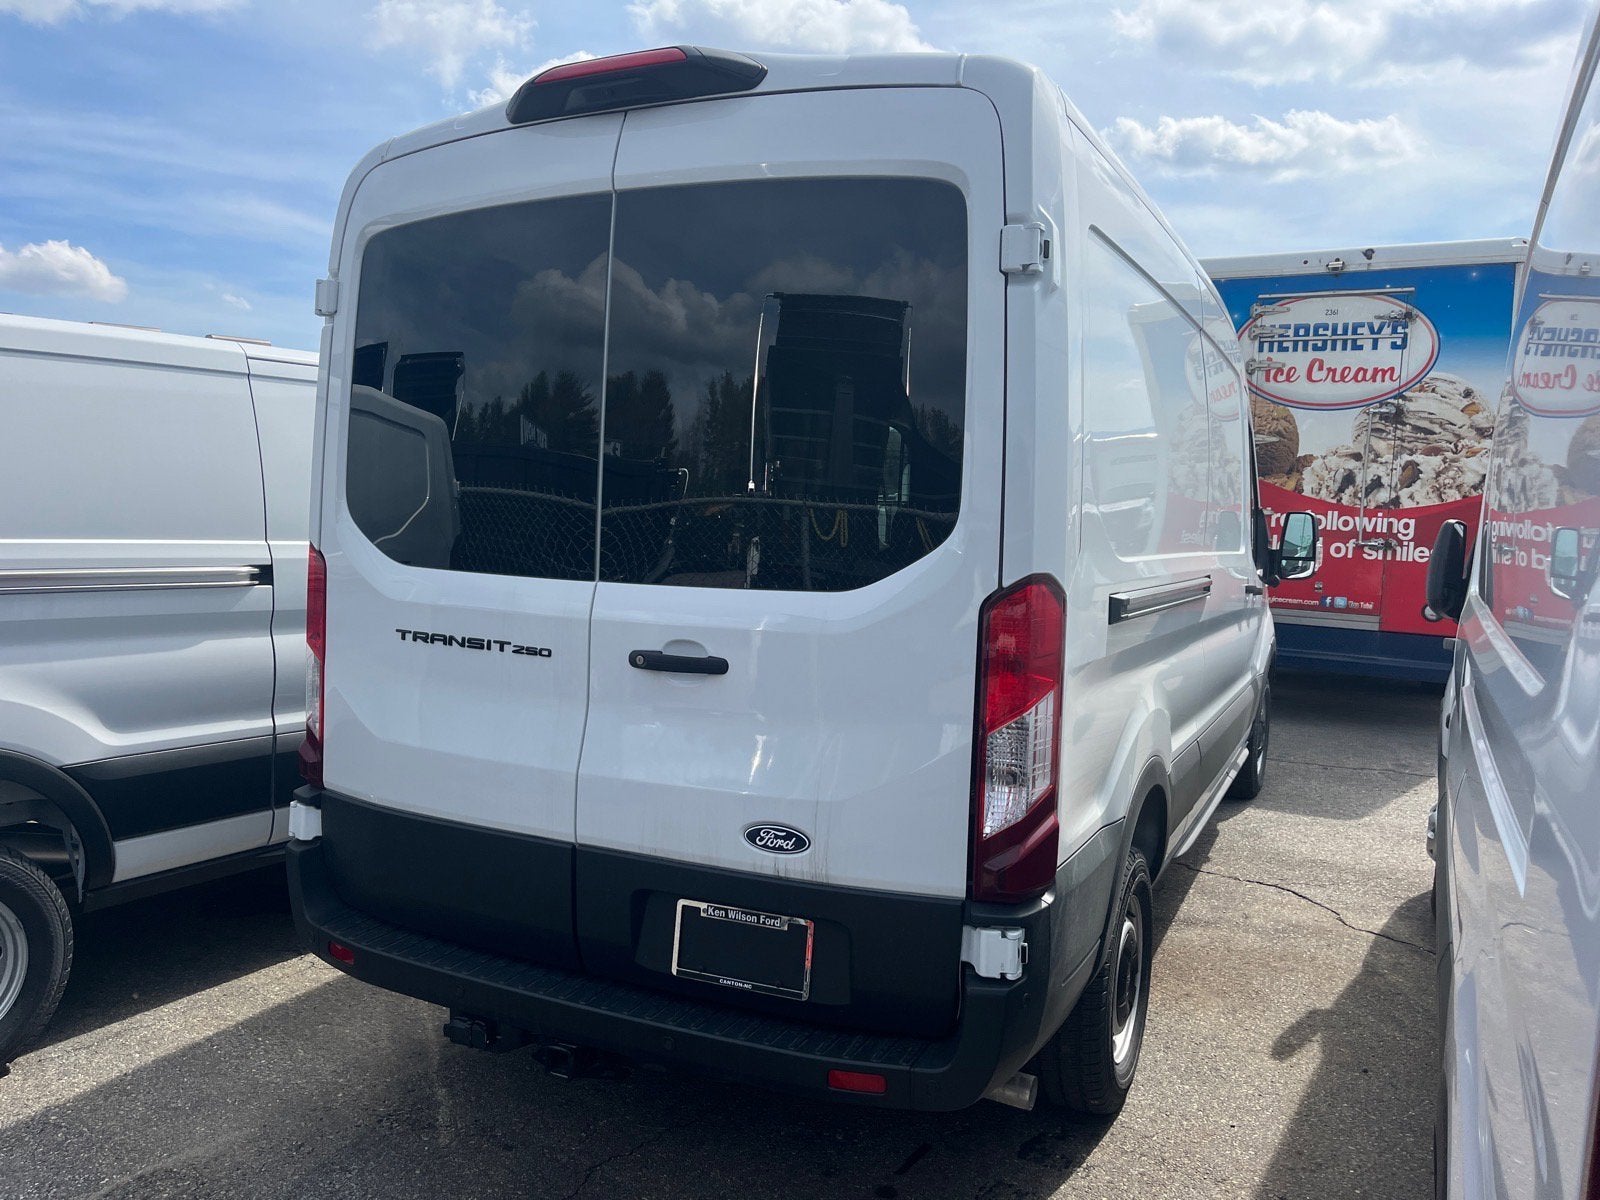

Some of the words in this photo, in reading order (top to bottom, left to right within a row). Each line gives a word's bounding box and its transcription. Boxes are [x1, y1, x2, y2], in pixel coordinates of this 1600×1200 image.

[1325, 308, 1339, 316] 2361
[1258, 321, 1409, 353] HERSHEY'S
[1306, 357, 1400, 384] Cream
[1306, 509, 1416, 541] ollowing
[1330, 538, 1358, 559] of
[1362, 541, 1434, 563] smile
[396, 628, 511, 652] TRANSIT
[512, 644, 552, 658] 250
[755, 828, 796, 850] Ford
[707, 905, 726, 919] Ken
[727, 910, 757, 923] Wilson
[759, 914, 781, 928] Ford
